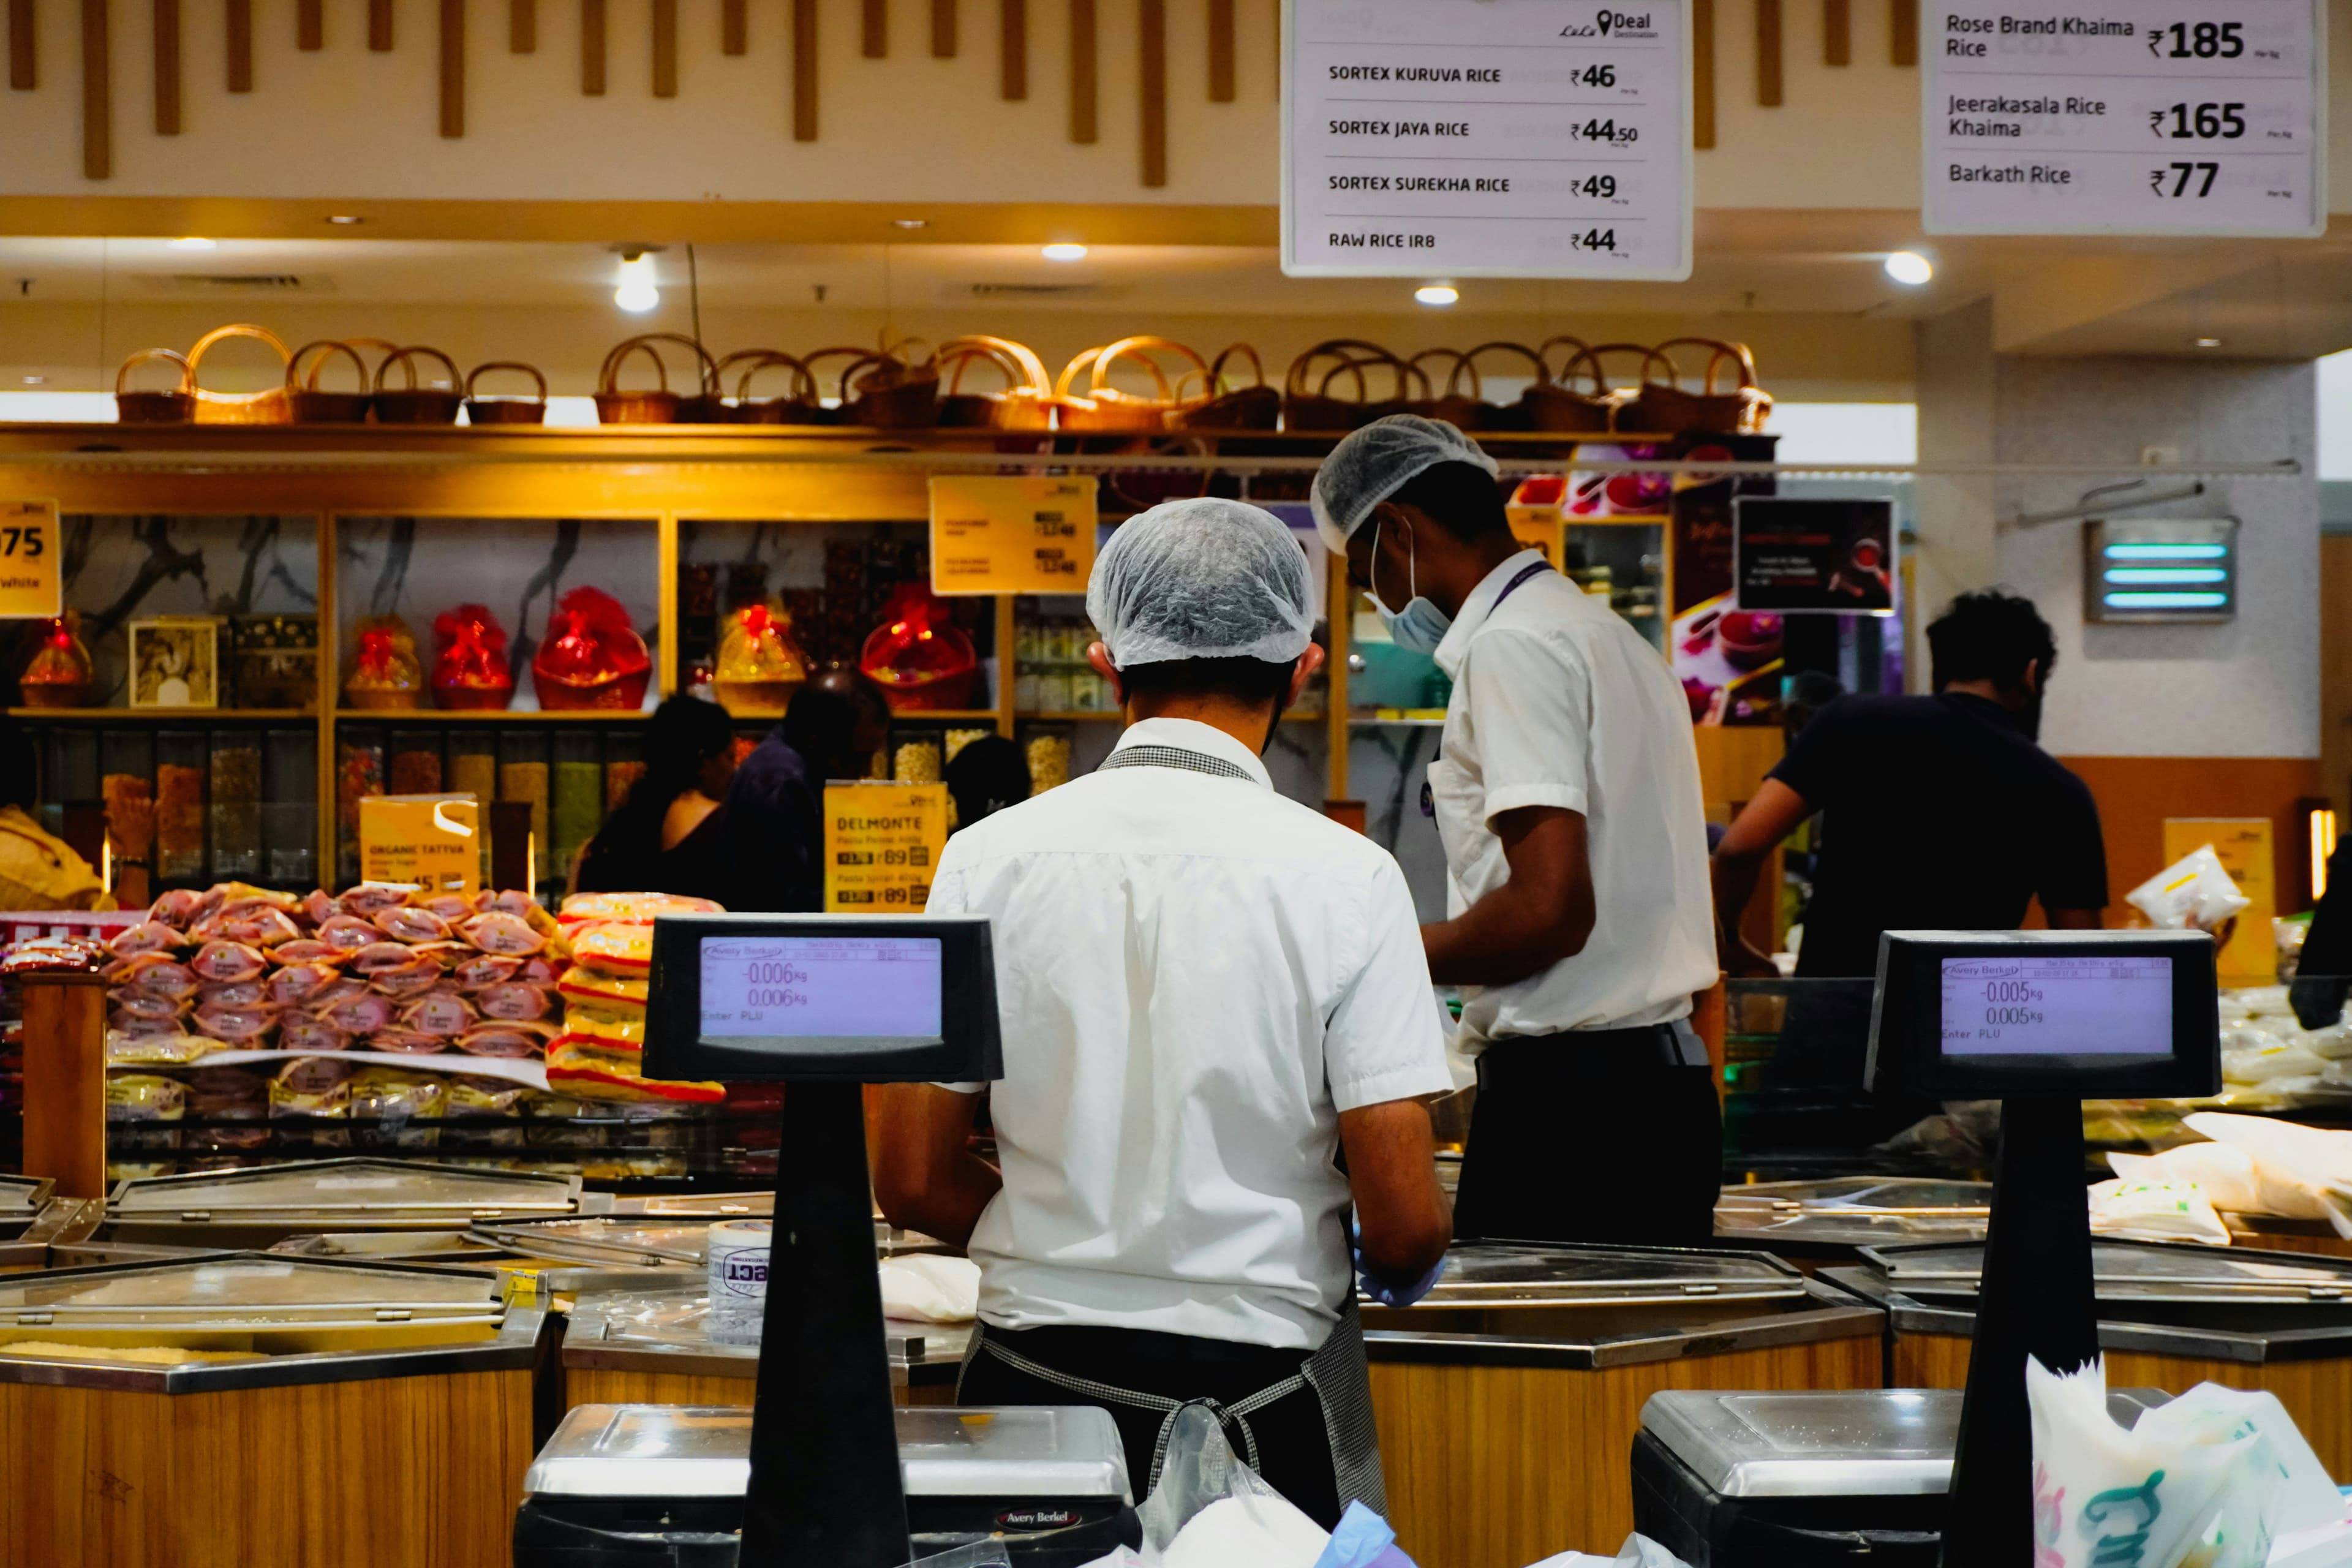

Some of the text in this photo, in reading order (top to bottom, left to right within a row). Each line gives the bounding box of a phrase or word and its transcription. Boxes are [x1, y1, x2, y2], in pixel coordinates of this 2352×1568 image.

[1614, 13, 1650, 28] Deal
[1947, 15, 2134, 36] Rose Brand Khaima
[1947, 39, 1987, 56] Rice
[2148, 22, 2244, 58] ₹185
[1329, 66, 1501, 83] SORTEX KURUVA RICE
[1570, 64, 1616, 87] ₹46
[1948, 95, 2106, 115] Jeerakasala Rice
[1949, 119, 2021, 137] Khaima
[2150, 102, 2245, 138] ₹165
[1329, 121, 1469, 138] SORTEX JAYA RICE
[1950, 164, 2071, 184] Barkath Rice
[2150, 162, 2219, 197] ₹77
[1329, 176, 1510, 192] SORTEX SUREKHA RICE
[1570, 175, 1616, 197] ₹49
[1329, 233, 1365, 247] RAW
[1370, 234, 1403, 247] RICE
[1570, 228, 1616, 251] ₹44
[0, 527, 43, 557] 75
[837, 816, 922, 831] DELMONTE
[370, 844, 464, 854] ORGANIC TATTVA
[1950, 965, 2015, 975] Avery Berkel
[702, 1011, 763, 1020] Enter PLU
[1942, 1029, 2000, 1039] Enter PLU
[1007, 1511, 1068, 1524] Avery Berkel
